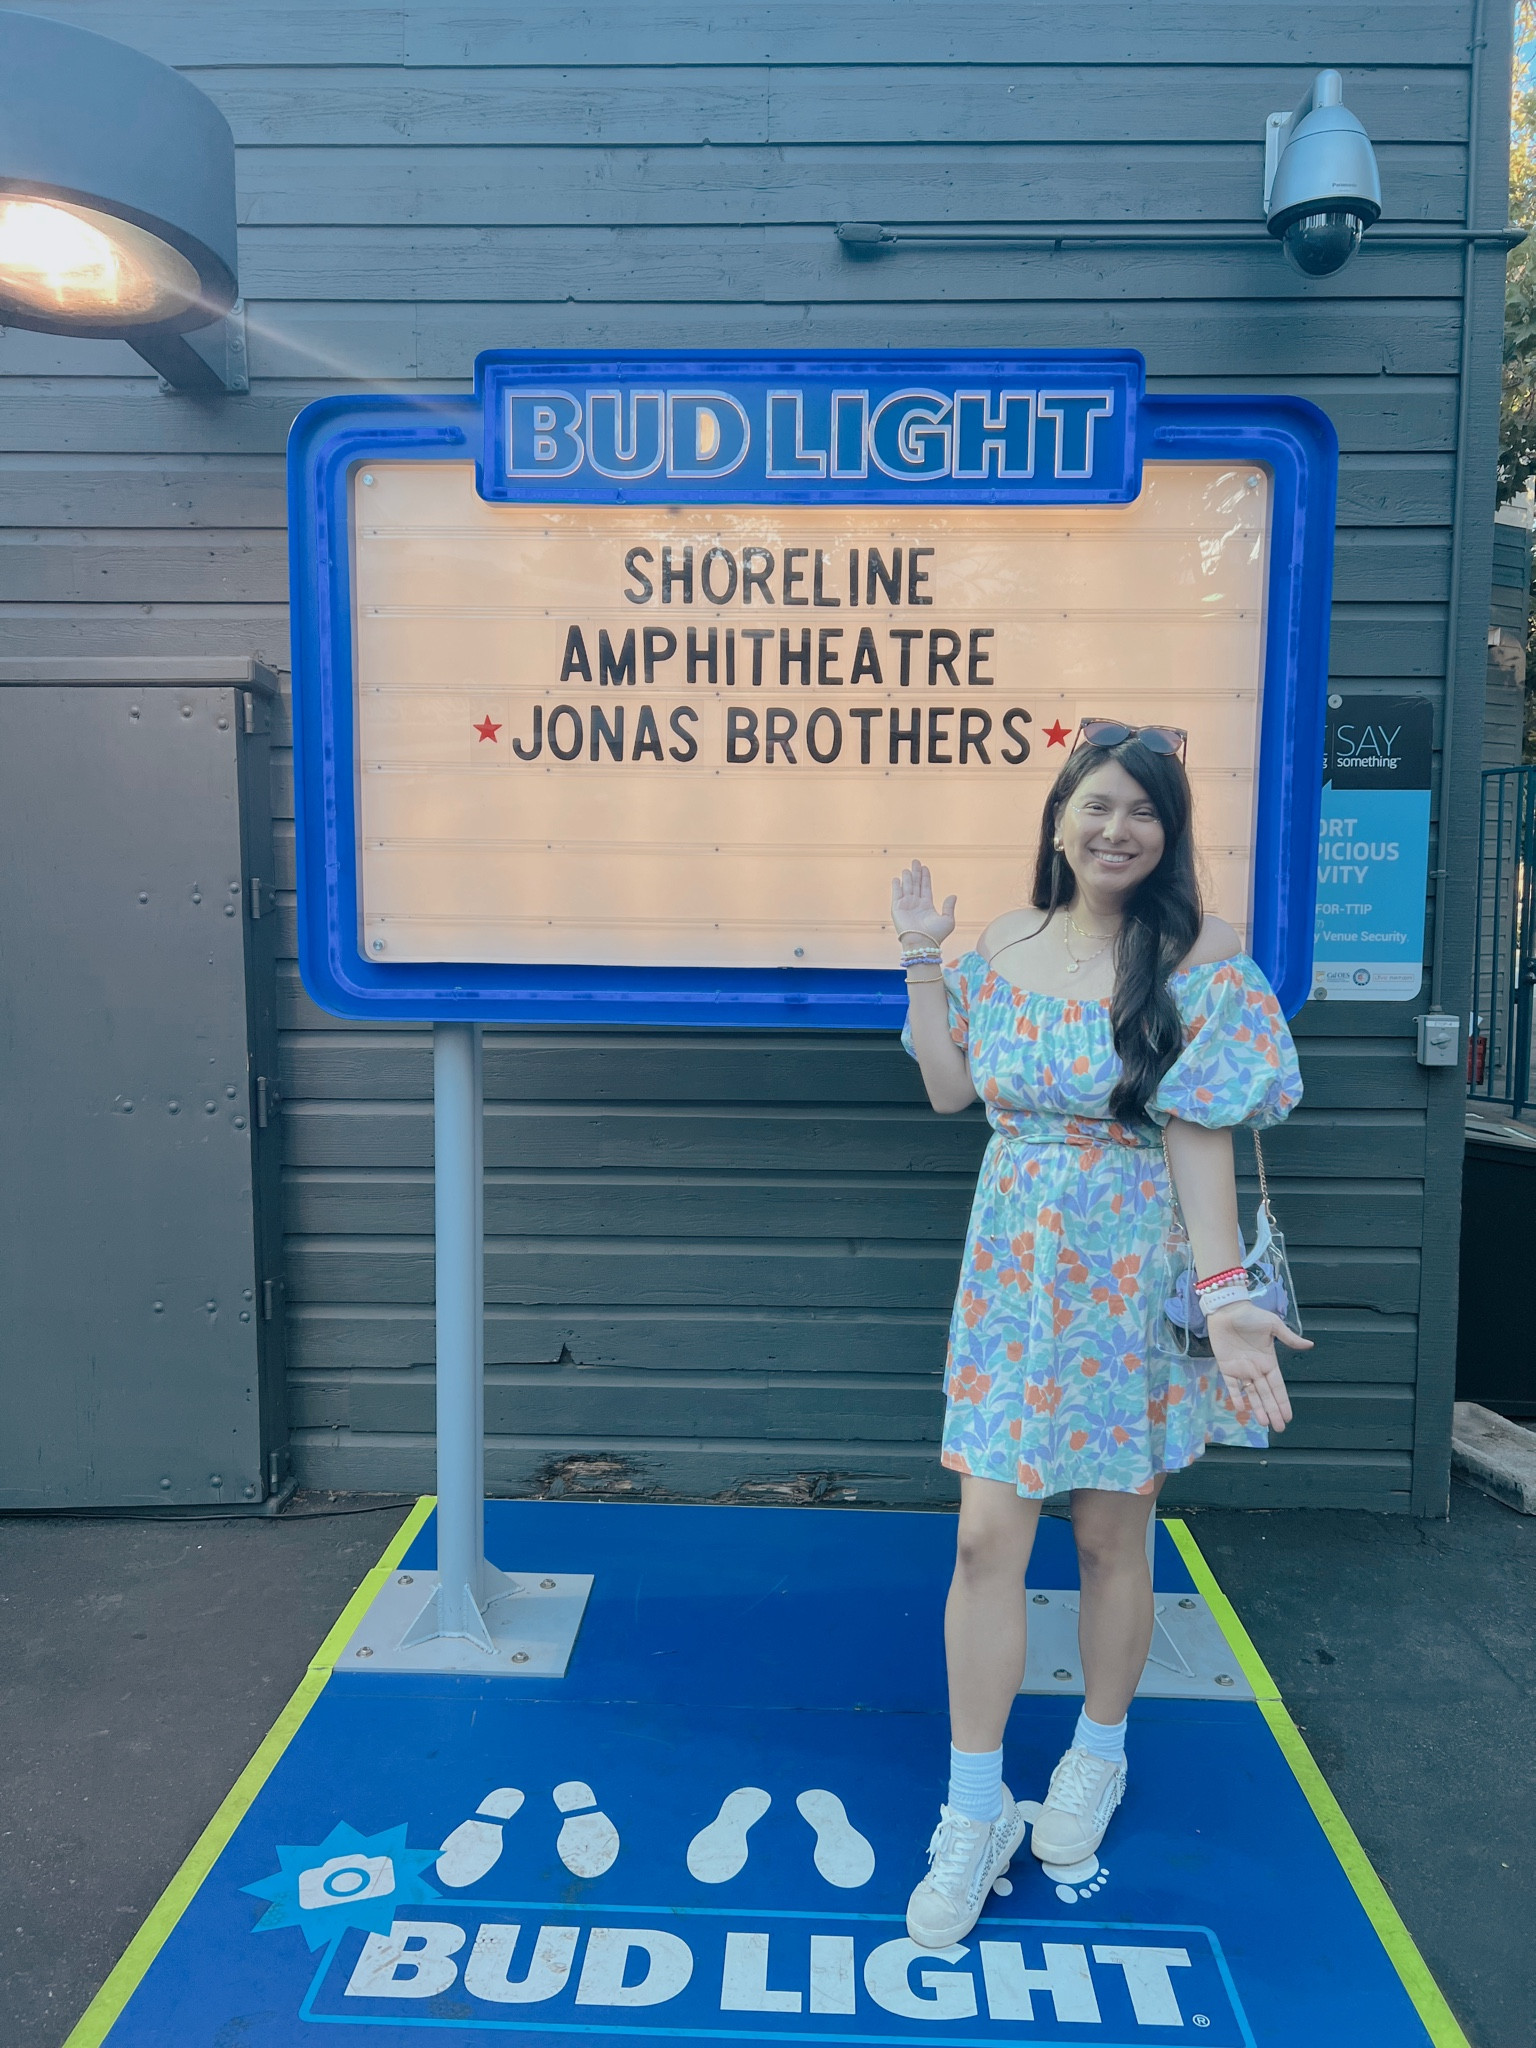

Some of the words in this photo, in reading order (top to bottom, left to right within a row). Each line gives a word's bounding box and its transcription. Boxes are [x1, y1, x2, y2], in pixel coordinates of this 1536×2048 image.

[504, 389, 751, 480] BUD
[766, 388, 1114, 482] LIGHT
[625, 547, 935, 607] SHORELINE
[561, 626, 995, 686] AMPHITHEATRE
[513, 705, 699, 763] JONAS
[727, 706, 1033, 765] BROTHERS
[1336, 725, 1401, 756] SAY
[1337, 756, 1397, 769] something
[1323, 931, 1358, 942] Venue
[344, 1920, 694, 2007] BUD
[720, 1932, 1192, 2026] LIGHT
